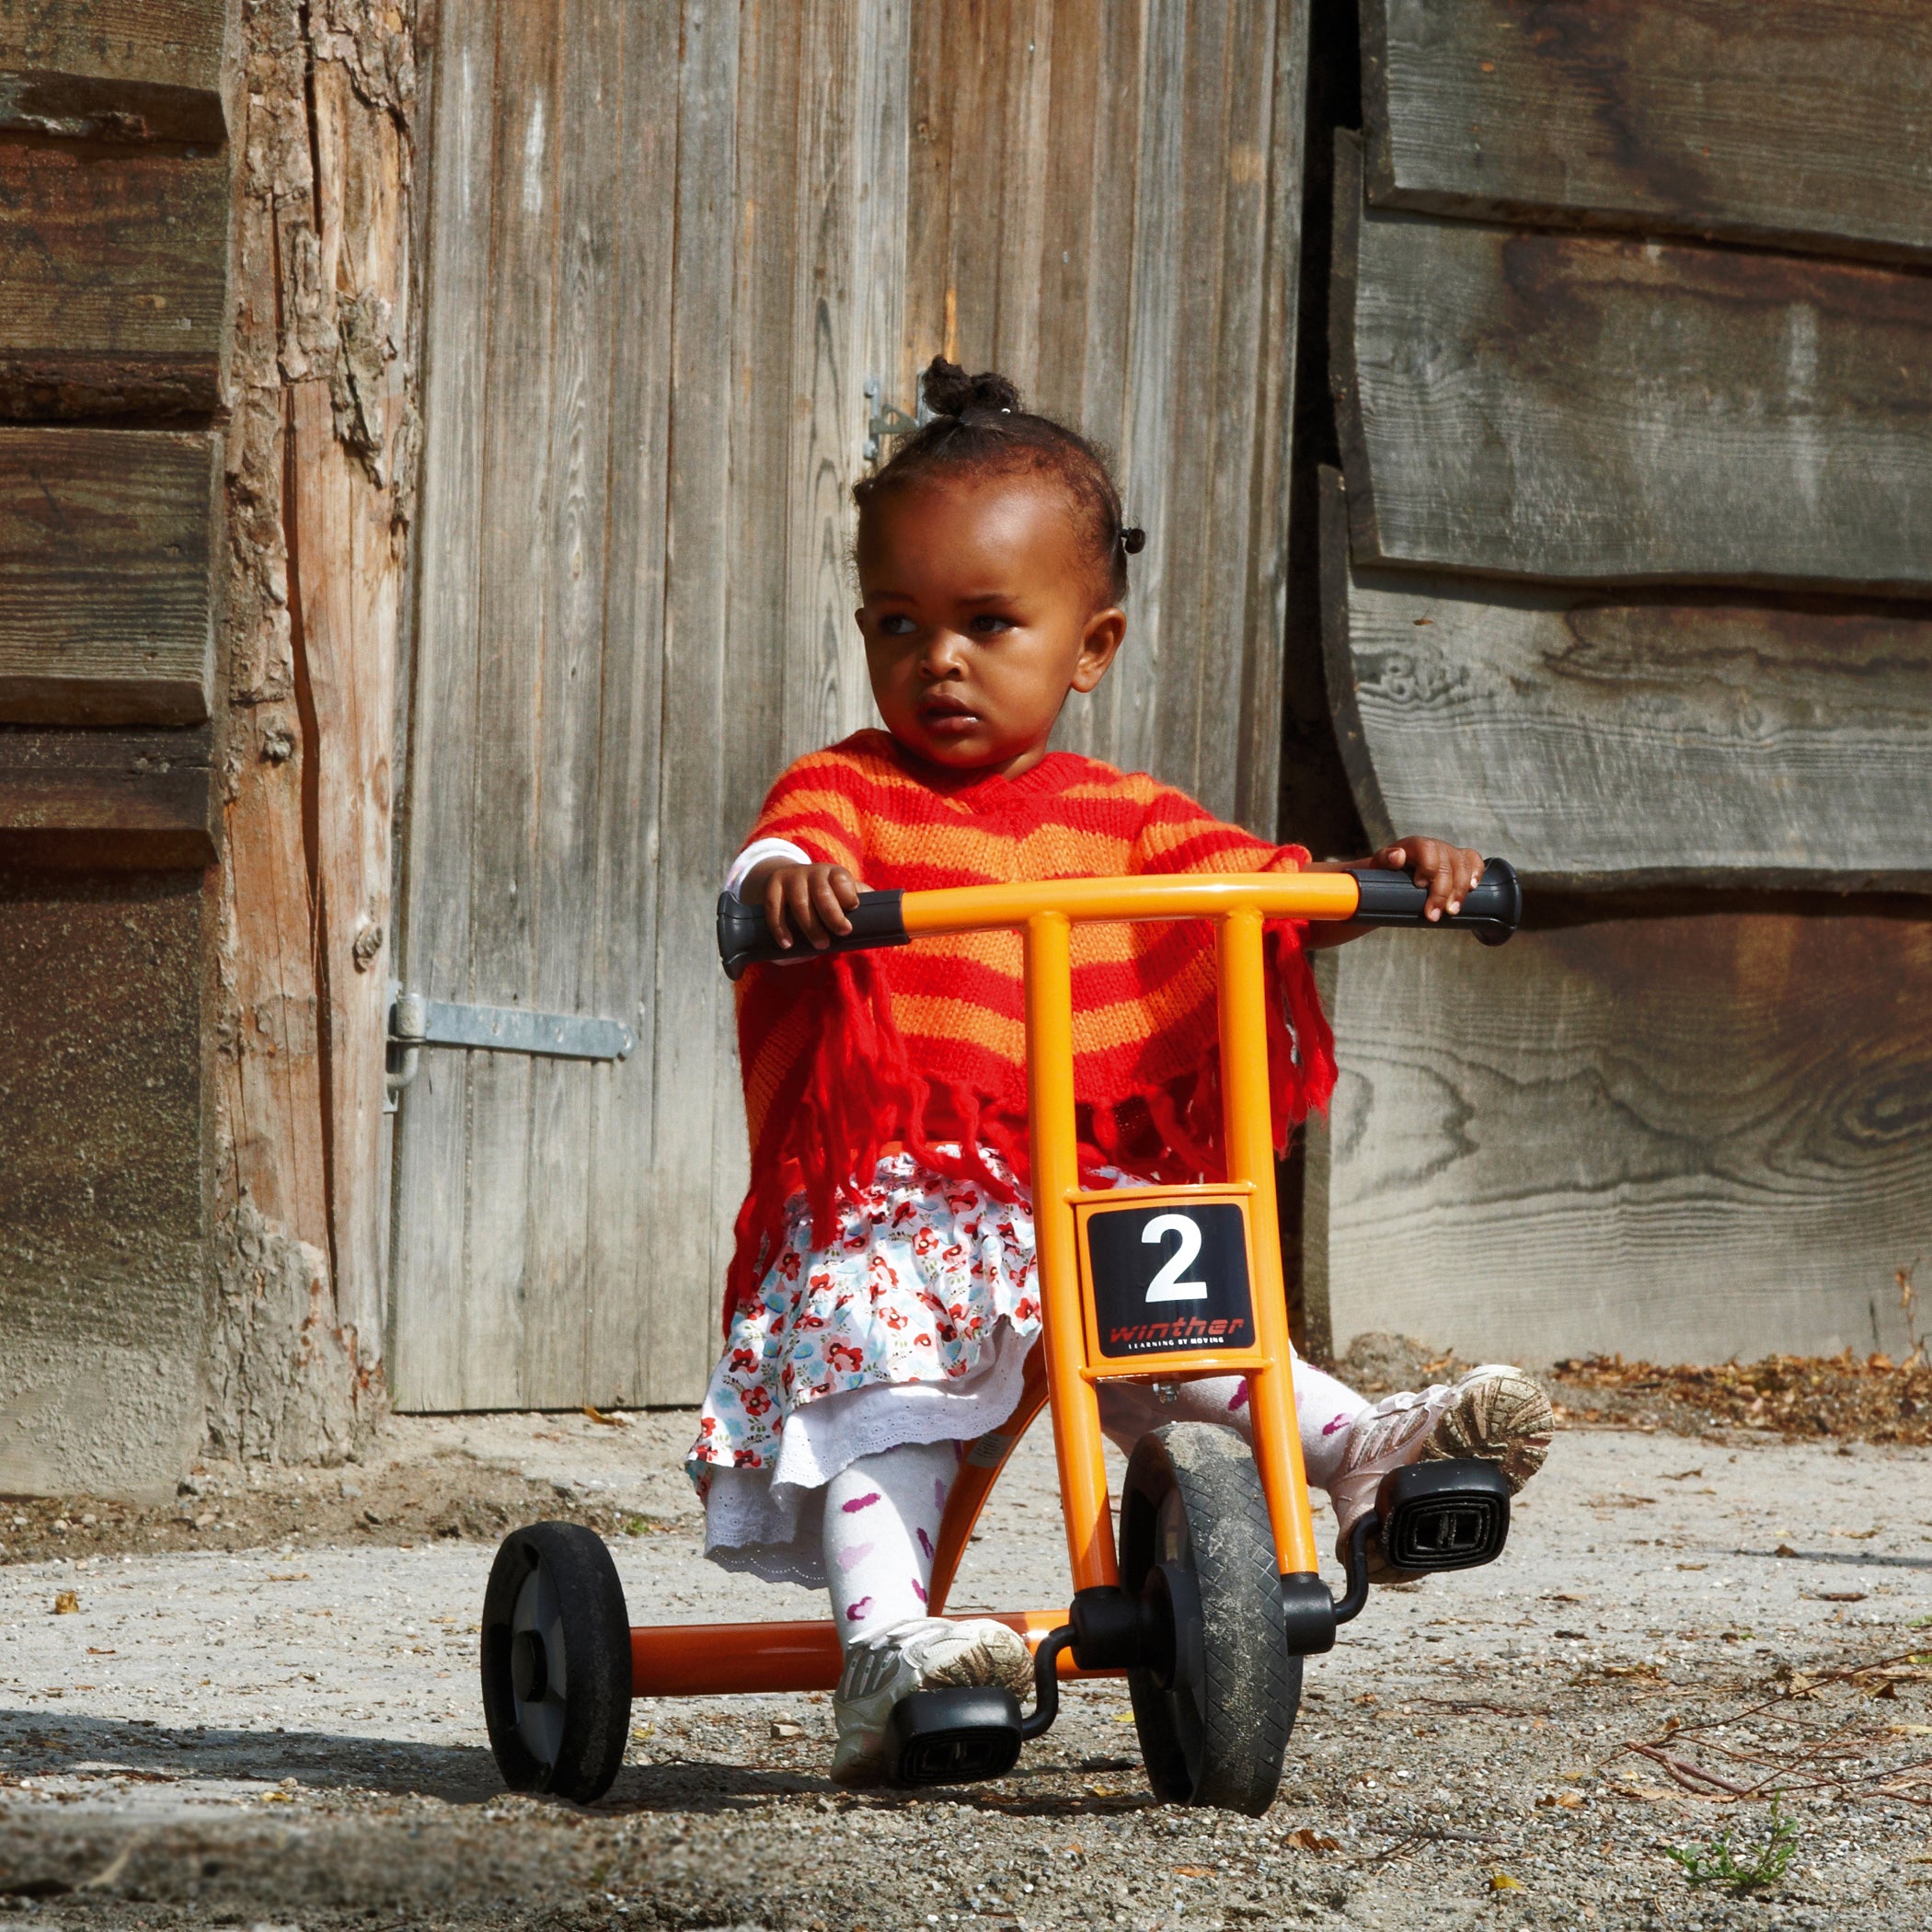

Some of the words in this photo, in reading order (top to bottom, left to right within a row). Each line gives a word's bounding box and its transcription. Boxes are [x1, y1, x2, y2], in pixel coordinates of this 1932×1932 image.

[1141, 1213, 1208, 1303] 2
[1110, 1316, 1245, 1343] winther
[1128, 1339, 1175, 1350] LEARNING
[1190, 1336, 1225, 1345] MOVING
